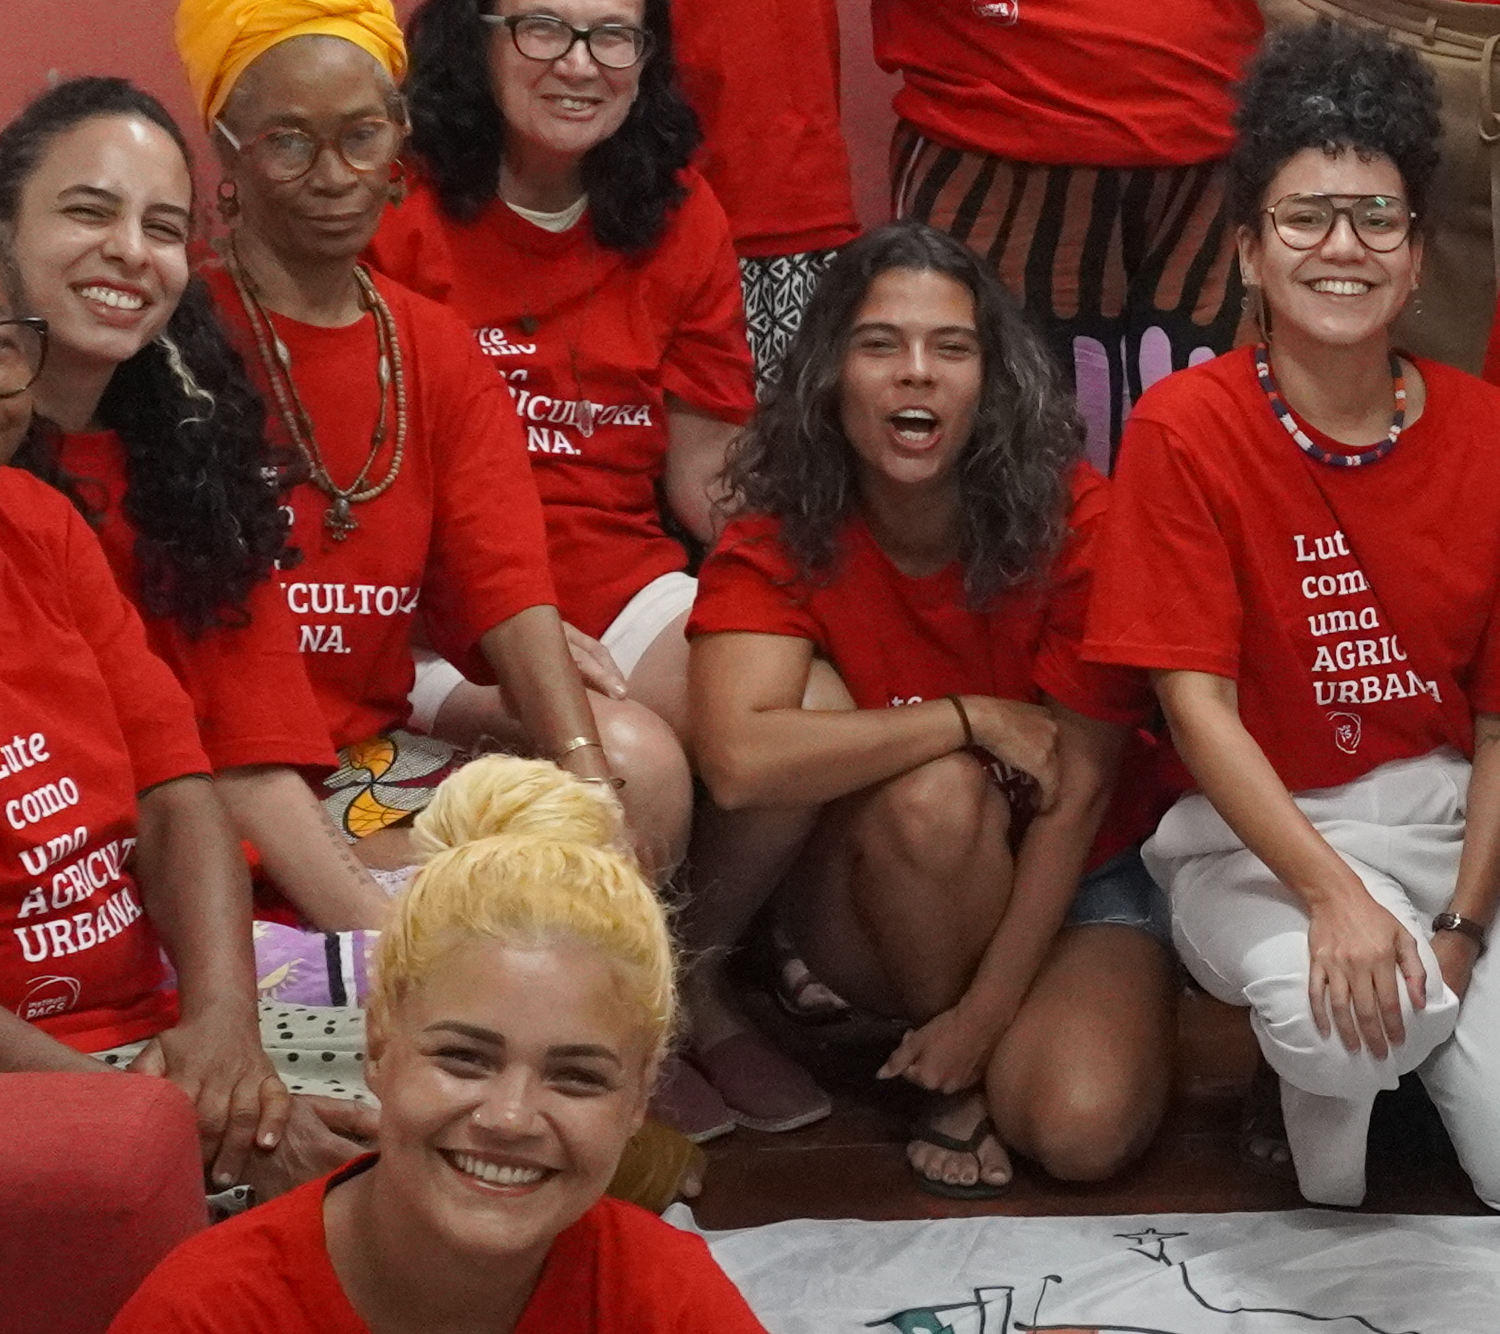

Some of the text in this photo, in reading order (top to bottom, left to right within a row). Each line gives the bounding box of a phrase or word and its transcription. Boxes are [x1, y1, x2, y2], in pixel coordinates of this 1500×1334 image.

[1301, 570, 1371, 599] com
[1308, 606, 1379, 637] uma
[5, 776, 79, 830] como
